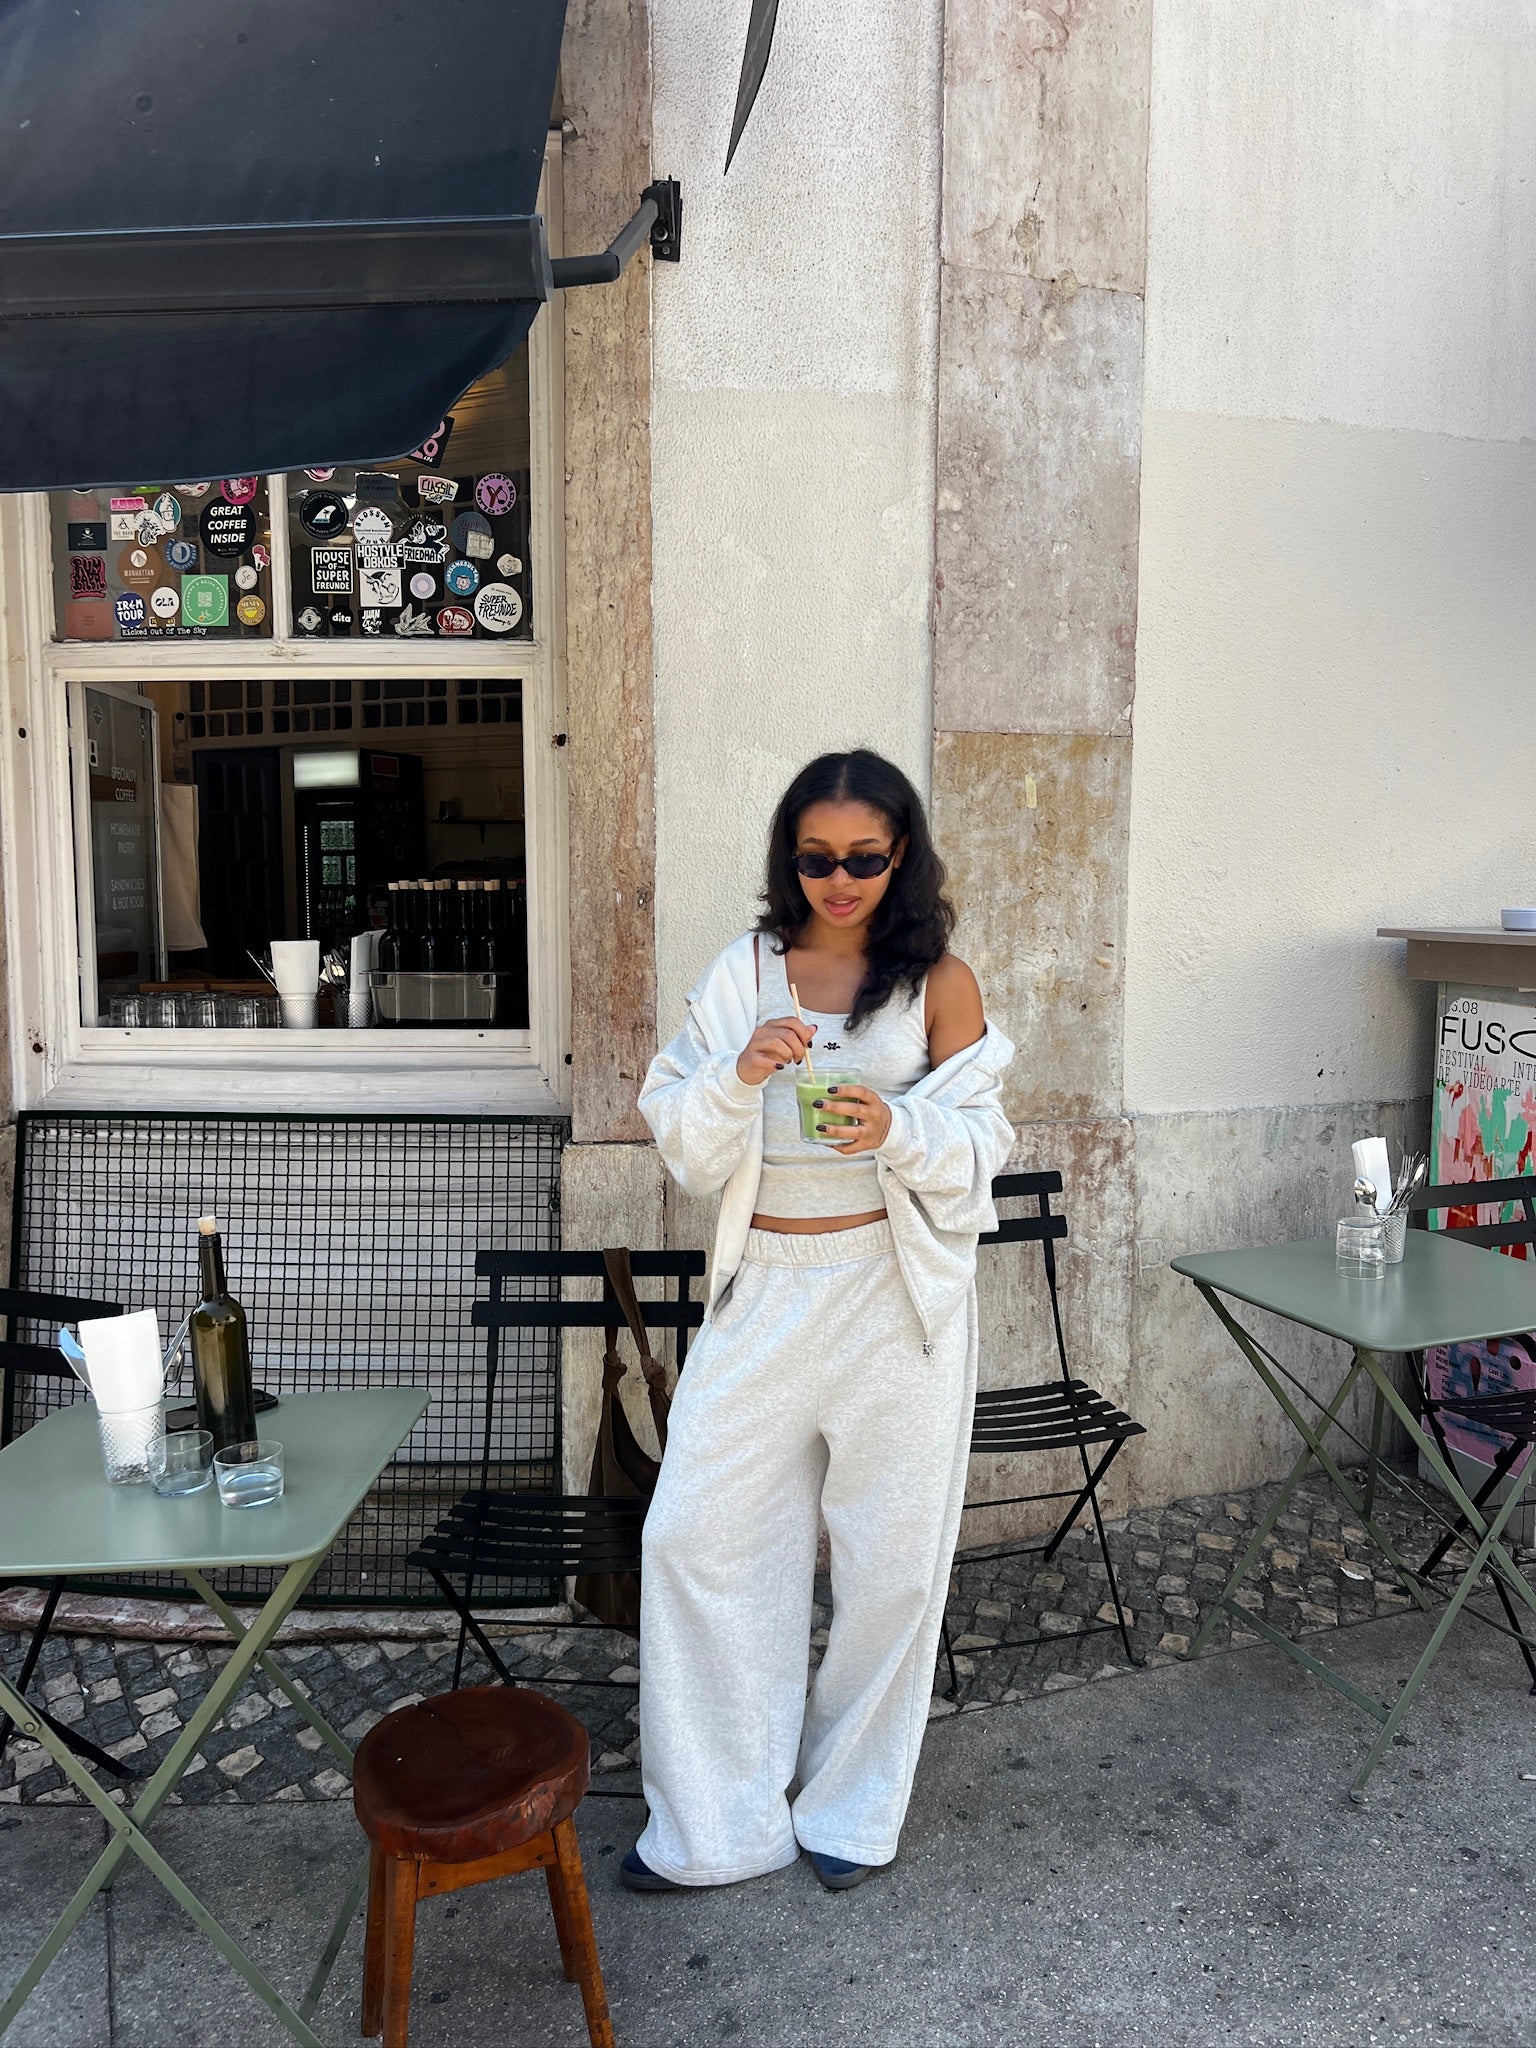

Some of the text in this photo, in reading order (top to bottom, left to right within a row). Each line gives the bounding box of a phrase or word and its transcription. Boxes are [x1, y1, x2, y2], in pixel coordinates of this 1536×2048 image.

[210, 505, 244, 518] GREAT
[355, 509, 390, 528] BLOSSOM
[207, 519, 247, 531] COFFEE
[210, 532, 246, 544] INSIDE
[357, 544, 403, 557] HOSTYLE
[404, 548, 445, 562] FRIEDHATS
[315, 551, 349, 565] HOUSE
[124, 569, 155, 577] MANHATTAN
[316, 569, 350, 581] SUPER
[316, 581, 350, 590] FREUNDE
[481, 594, 508, 604] SUPER
[117, 608, 145, 622] TOUR
[332, 612, 352, 623] dita
[478, 602, 517, 620] FREUNDE
[121, 628, 148, 636] Kicked
[166, 627, 175, 635] Of
[177, 627, 191, 635] The
[193, 626, 208, 636] Sky
[111, 766, 137, 783] SPECIALTY
[115, 788, 135, 802] COFFEE
[110, 822, 141, 836] HOMEMADE
[118, 841, 136, 854] PASTRY
[110, 878, 145, 892] SANDWICHES
[118, 896, 128, 910] HOT
[129, 895, 145, 909] FOOD
[1439, 1048, 1487, 1072] FESTIVAL
[1438, 1065, 1451, 1083] DE
[1463, 1071, 1521, 1097] VIDEOARTE
